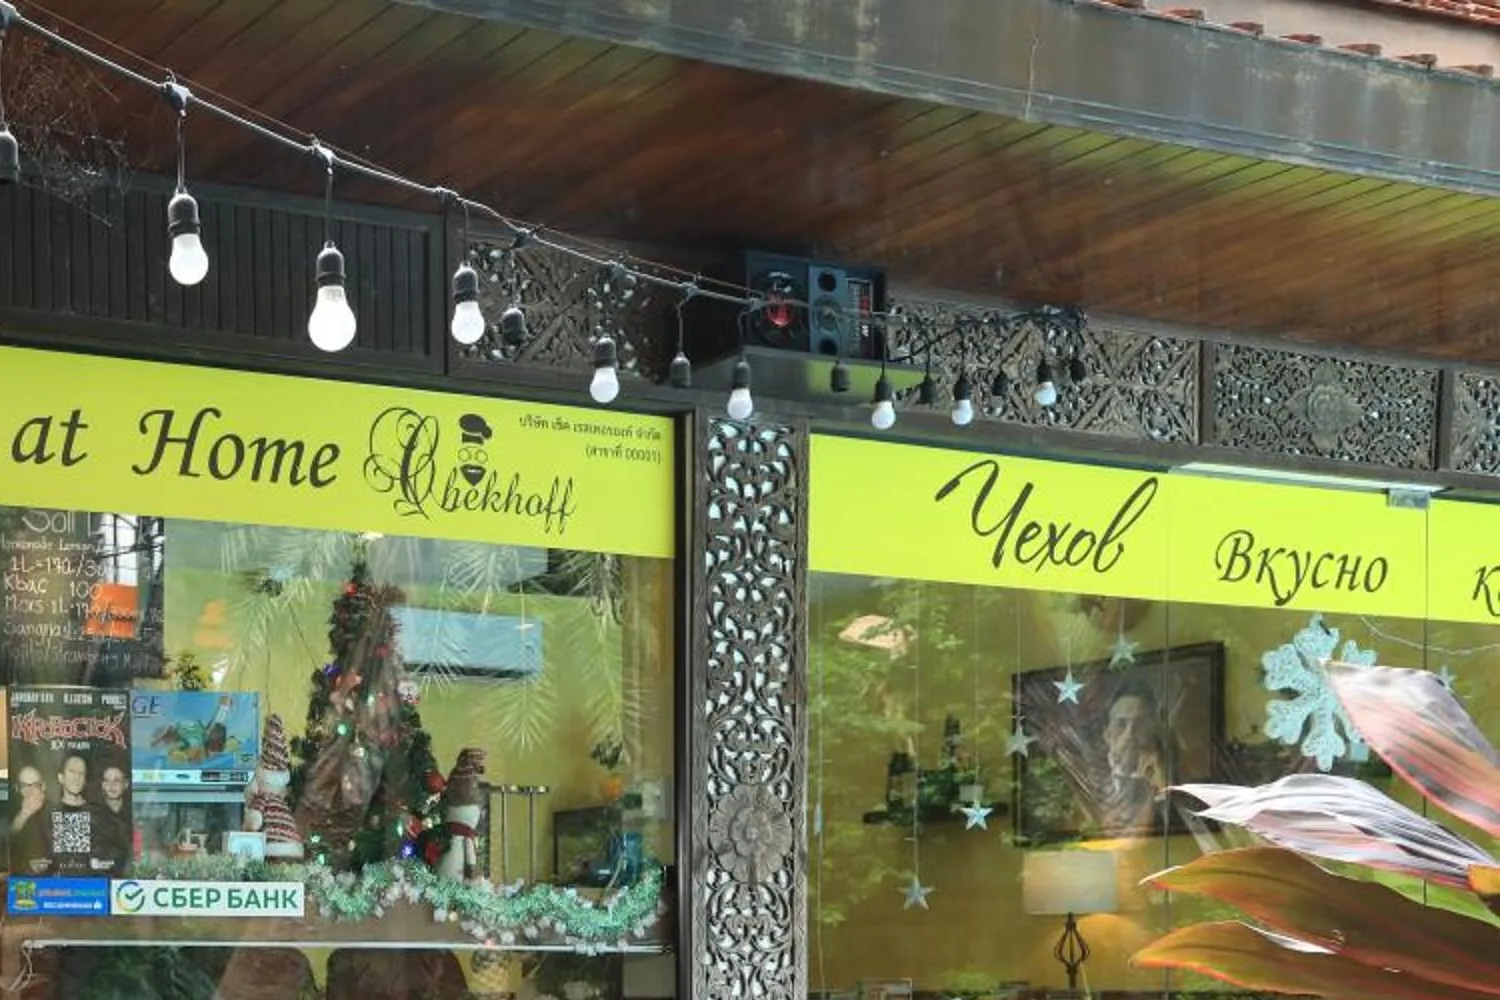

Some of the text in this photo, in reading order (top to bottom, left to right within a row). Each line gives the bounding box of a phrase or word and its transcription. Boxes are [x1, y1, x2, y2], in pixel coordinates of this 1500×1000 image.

[10, 408, 89, 467] at
[130, 407, 342, 488] Home
[934, 459, 1388, 607] Чехов Вкусно
[153, 887, 299, 910] СБЕР БАНК
